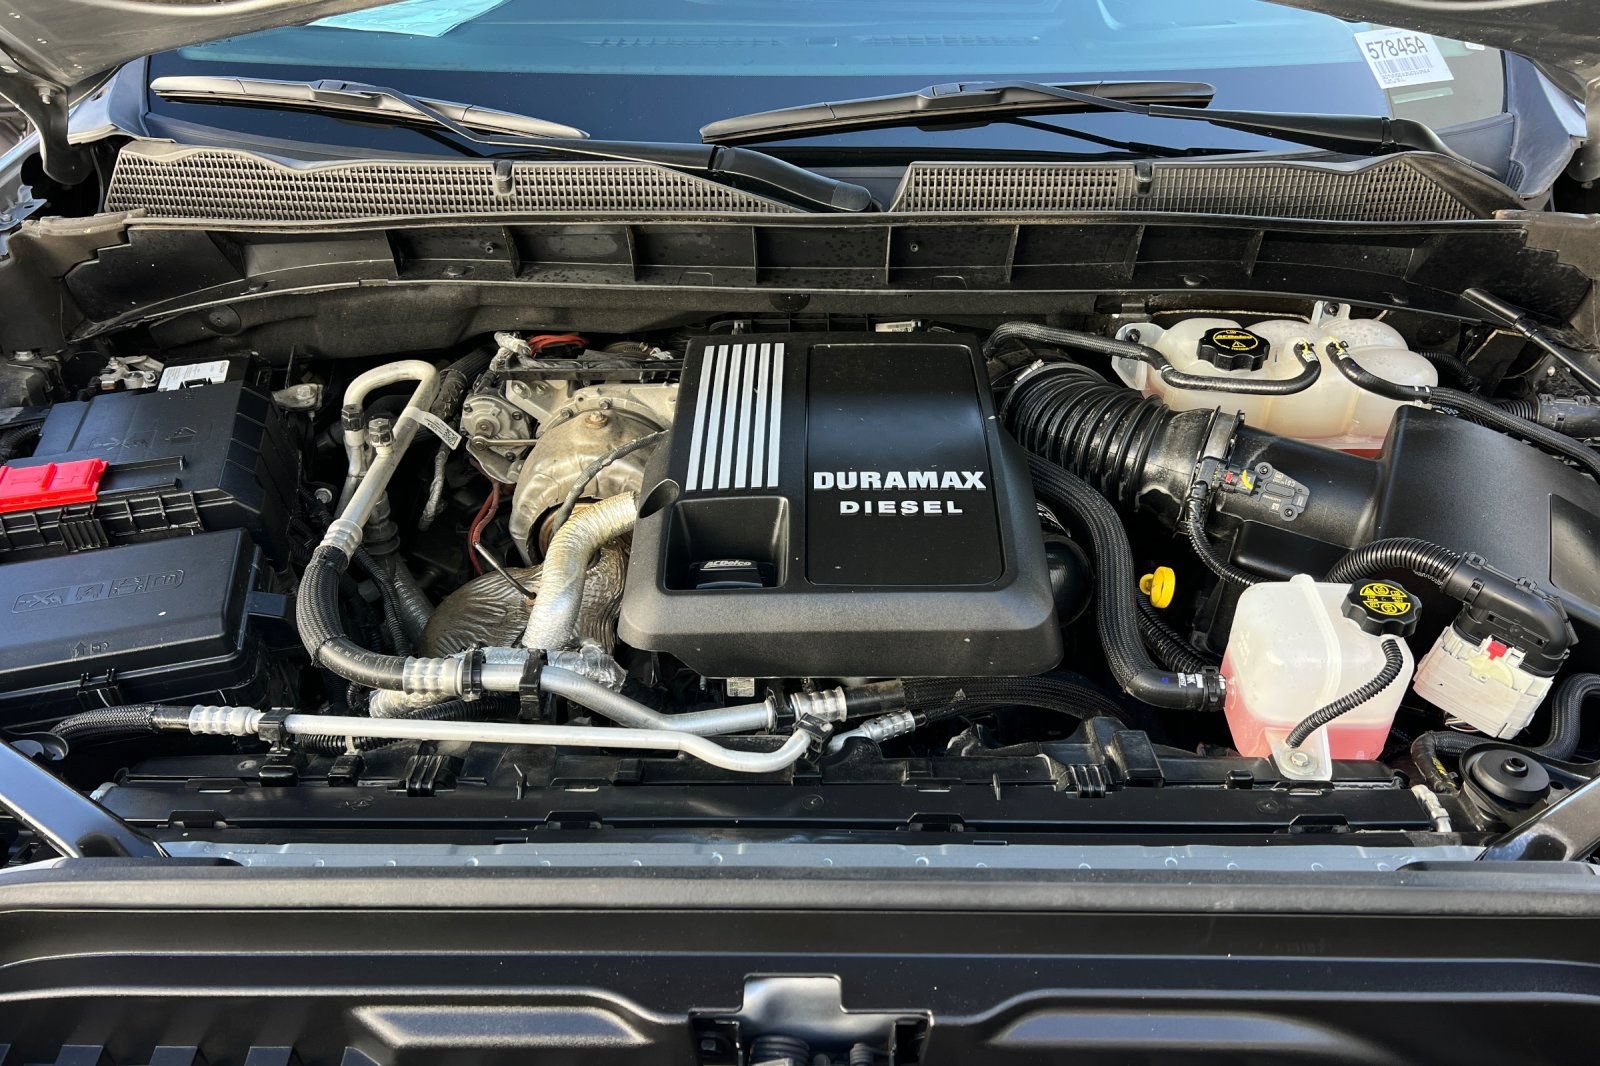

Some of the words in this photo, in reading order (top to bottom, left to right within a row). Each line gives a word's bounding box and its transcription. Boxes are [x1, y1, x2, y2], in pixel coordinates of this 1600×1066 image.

[1365, 36, 1428, 59] 57845A
[813, 471, 987, 490] DURAMAX
[839, 501, 963, 516] DIESEL
[703, 560, 752, 569] ACDelco
